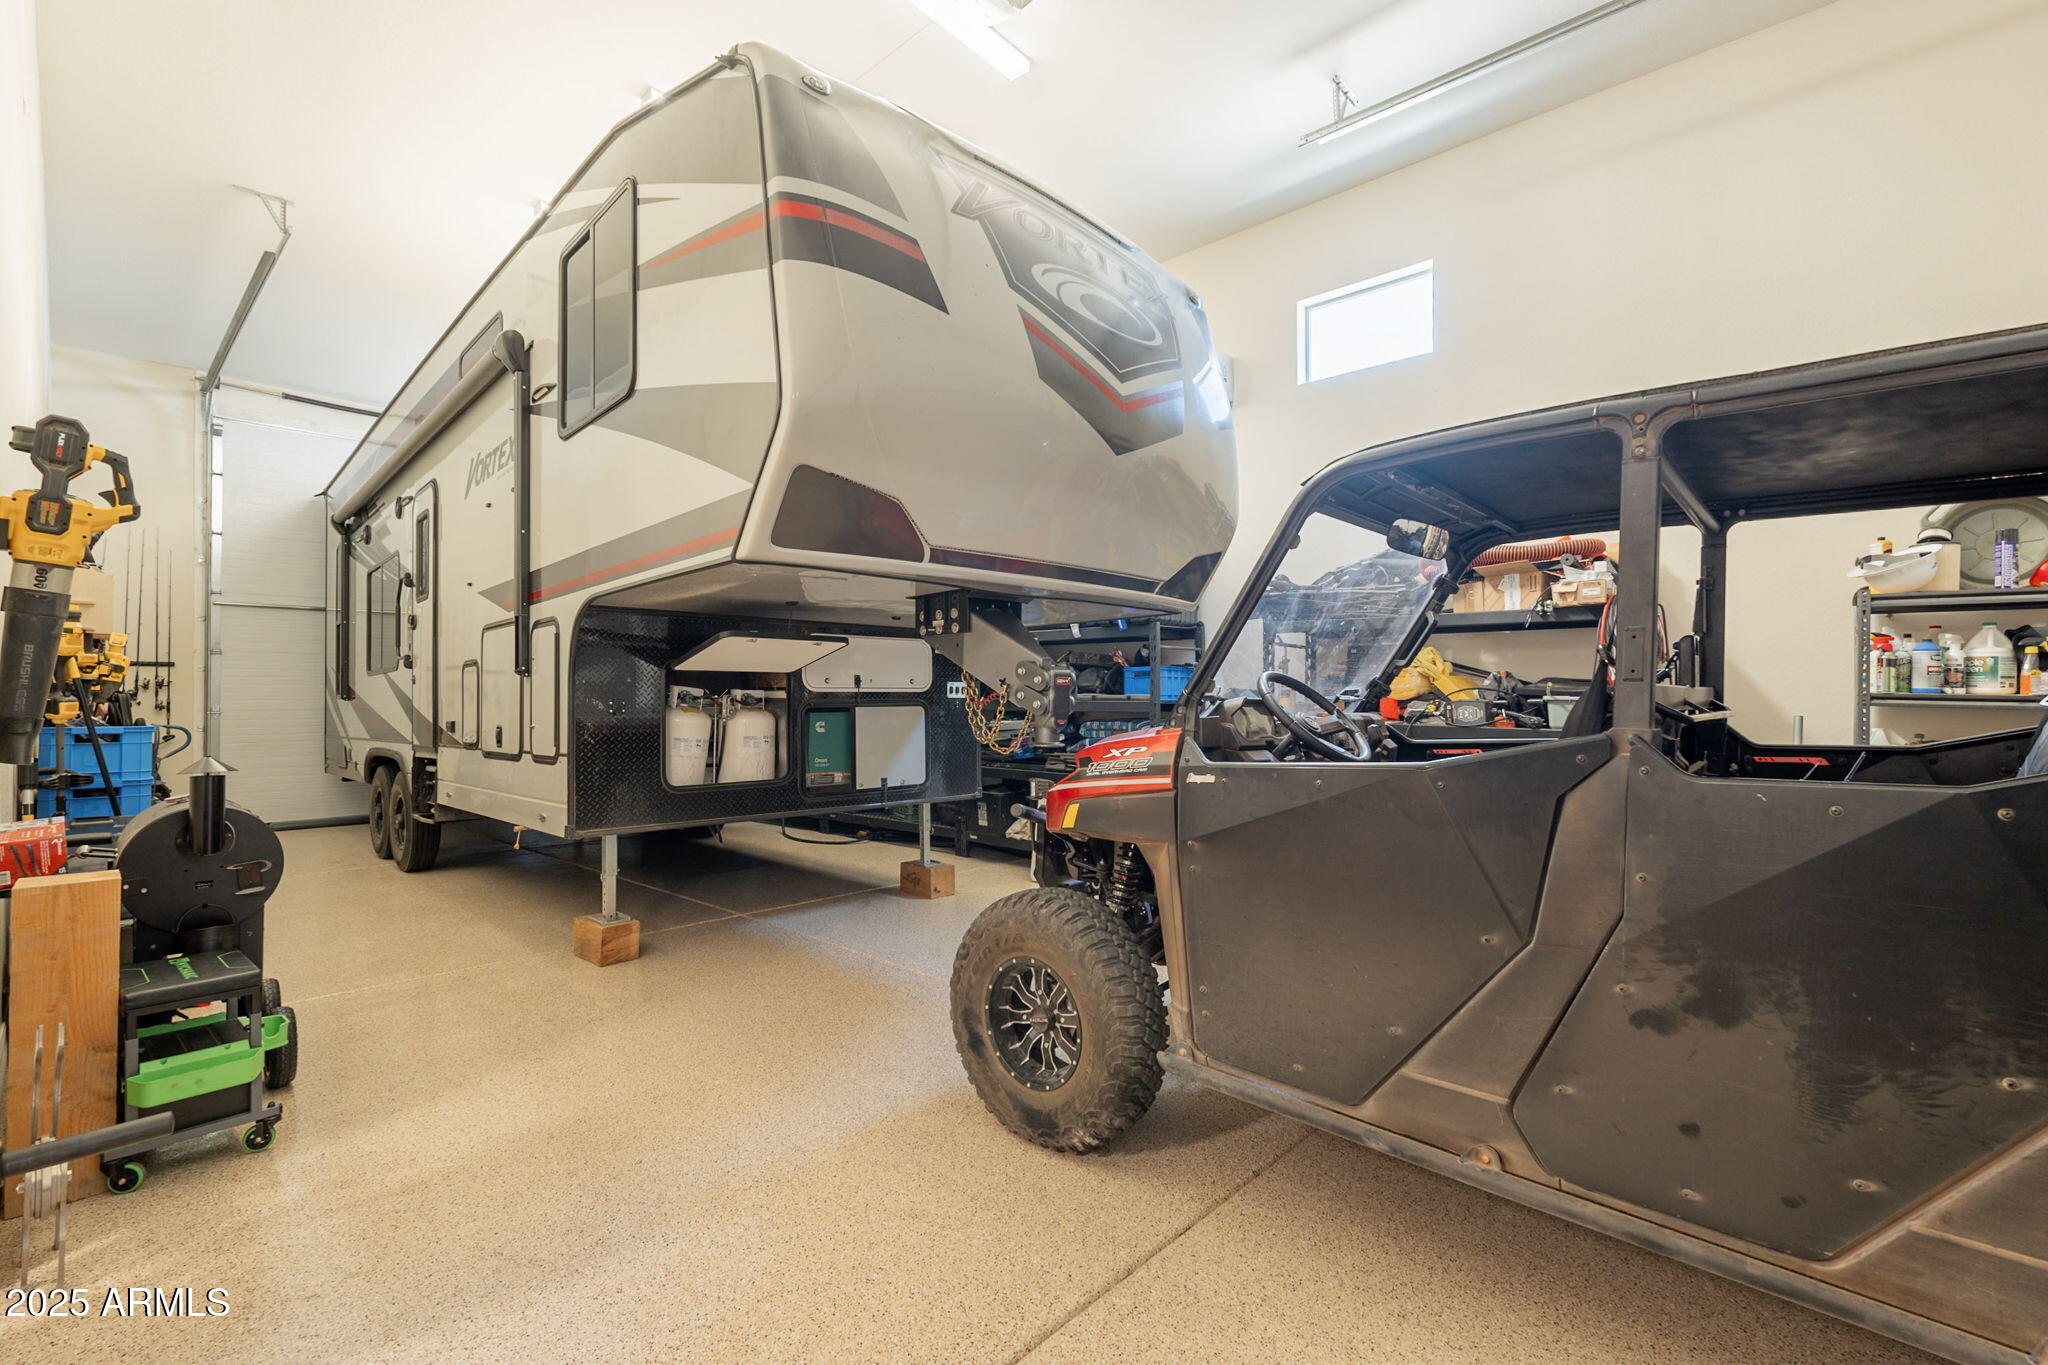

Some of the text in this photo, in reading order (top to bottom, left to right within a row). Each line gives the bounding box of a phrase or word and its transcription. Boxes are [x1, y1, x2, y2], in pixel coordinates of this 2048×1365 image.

[14, 644, 34, 712] BRUSHESS
[1103, 746, 1148, 758] XP
[1086, 757, 1153, 773] 1000
